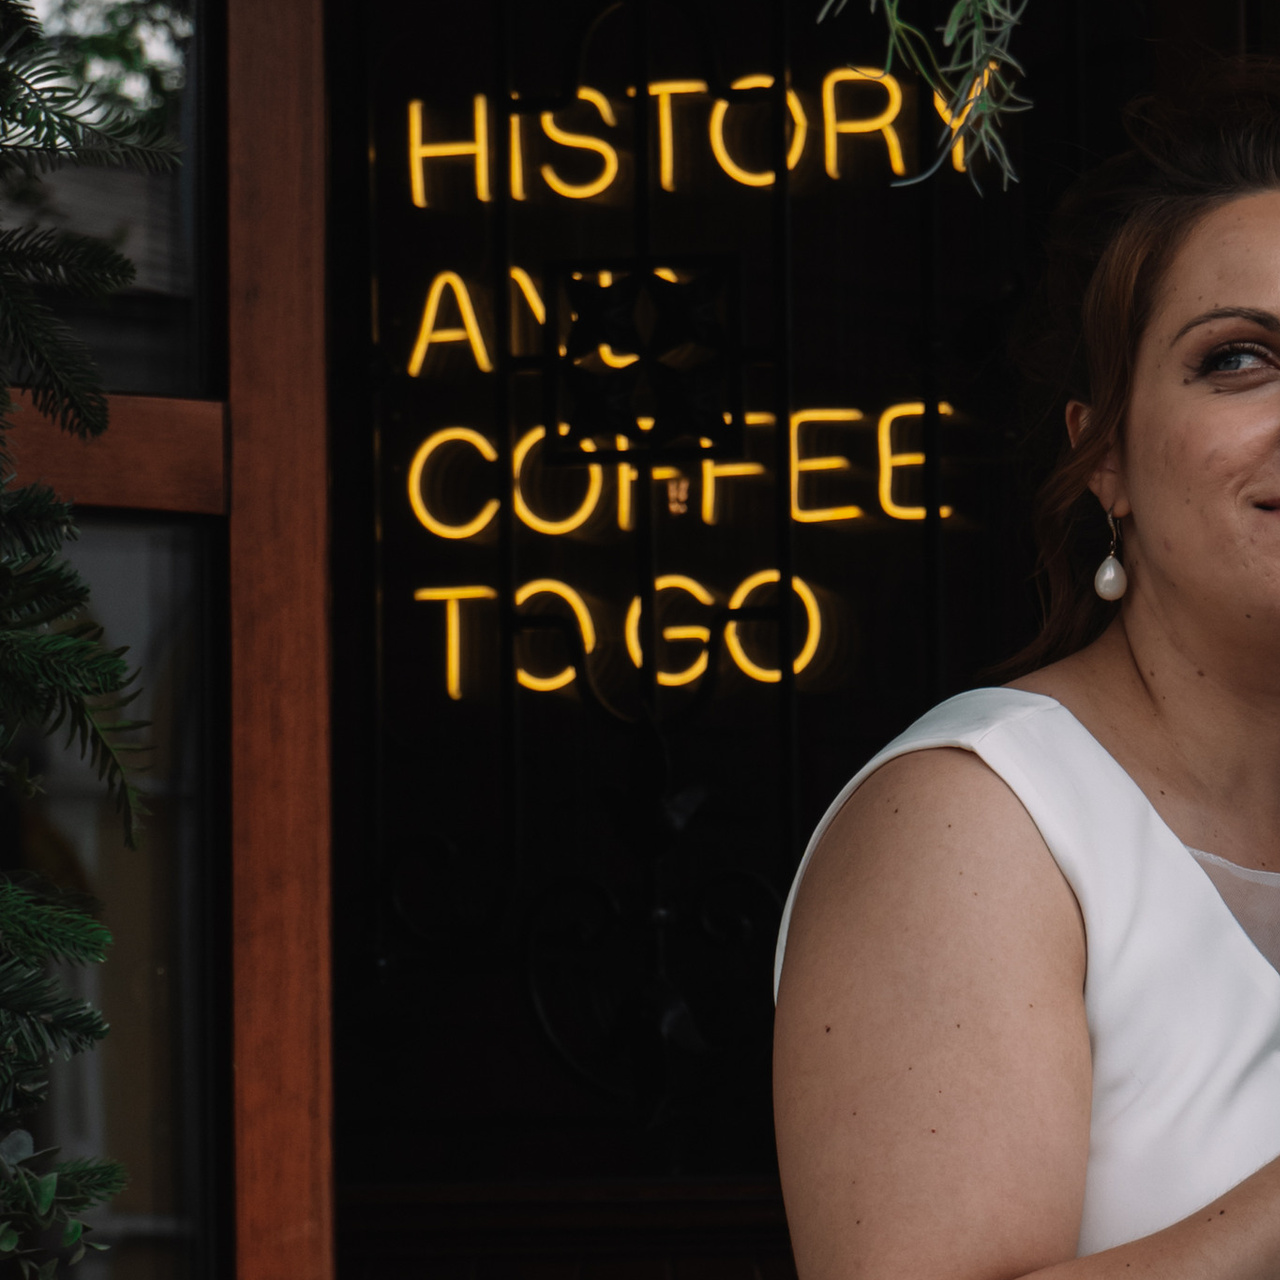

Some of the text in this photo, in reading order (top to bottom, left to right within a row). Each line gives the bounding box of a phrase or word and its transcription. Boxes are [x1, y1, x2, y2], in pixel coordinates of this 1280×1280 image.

[406, 60, 1001, 209] HISTORY
[412, 567, 823, 700] TO GO
